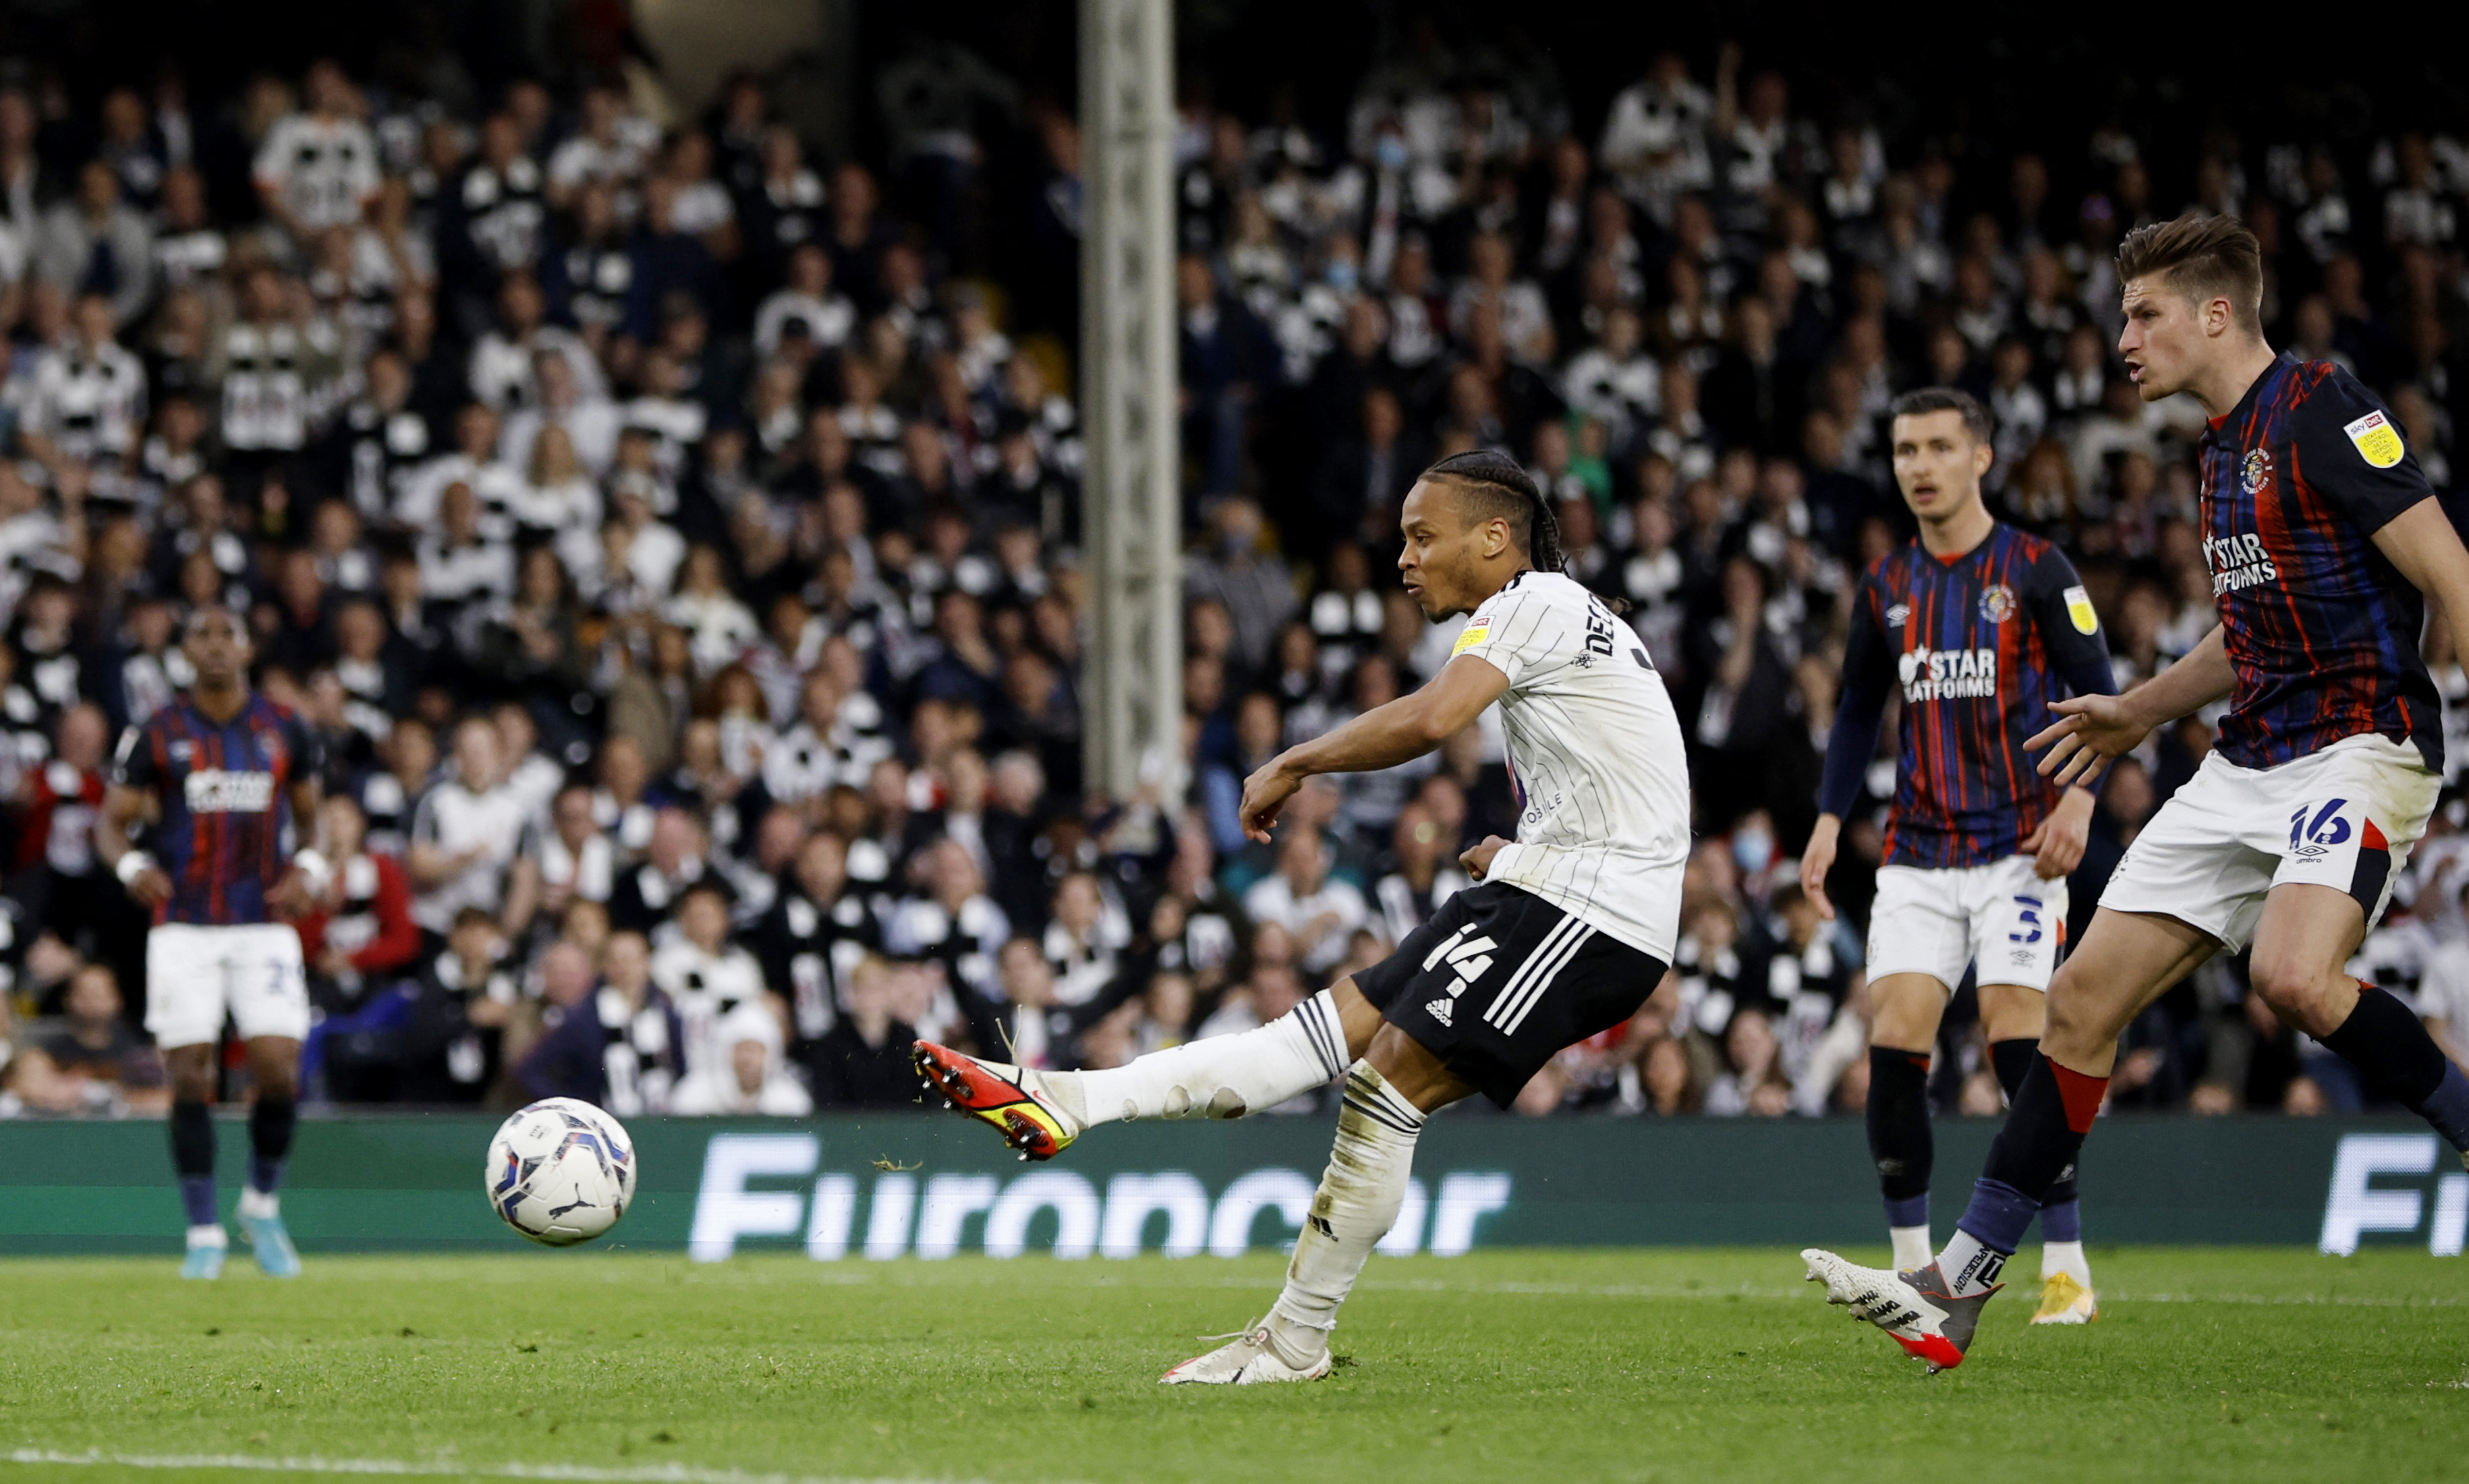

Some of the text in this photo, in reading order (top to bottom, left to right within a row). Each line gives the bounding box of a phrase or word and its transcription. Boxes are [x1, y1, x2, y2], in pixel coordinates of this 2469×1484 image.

[2350, 416, 2382, 434] sky bet
[2364, 432, 2377, 441] STAY
[2371, 441, 2393, 455] DEPOSIT
[2379, 448, 2393, 457] LIMIT
[2215, 533, 2269, 569] STAR
[1929, 648, 1996, 681] STAR
[2289, 798, 2352, 850] 16
[2296, 857, 2322, 865] umbro
[2009, 896, 2043, 943] 3
[1422, 922, 1498, 999] 14
[1425, 1002, 1453, 1027] adidas
